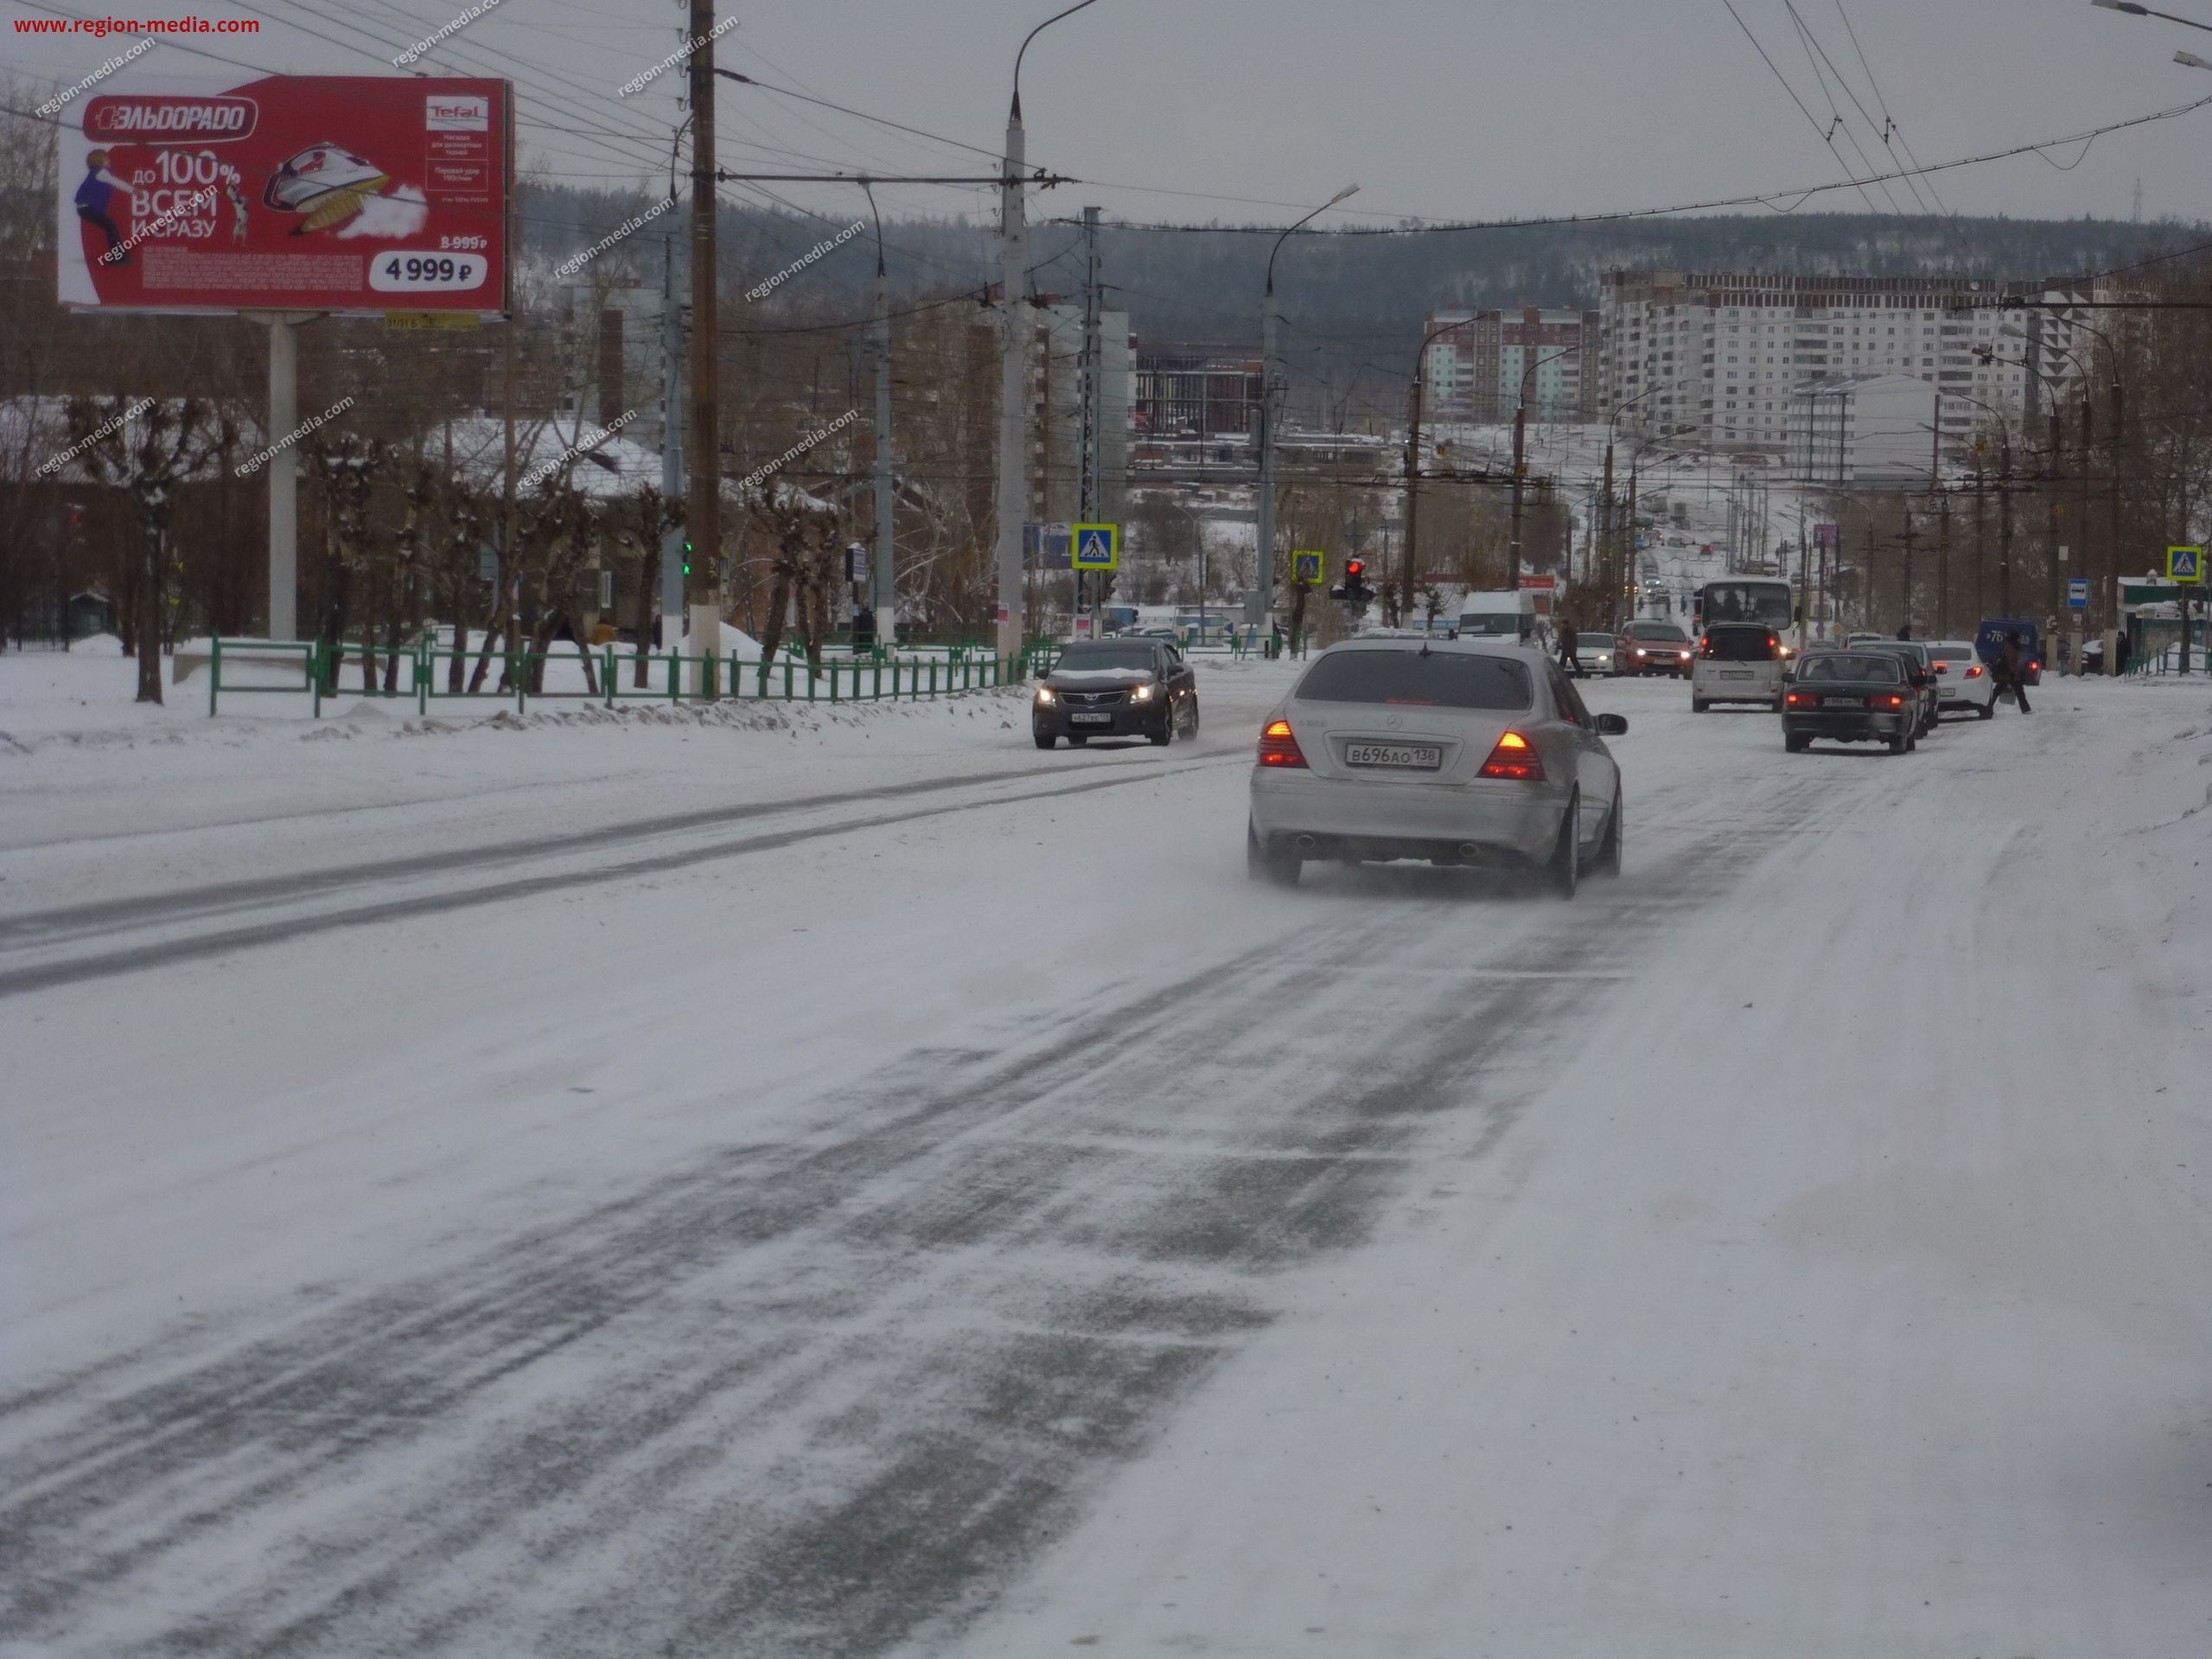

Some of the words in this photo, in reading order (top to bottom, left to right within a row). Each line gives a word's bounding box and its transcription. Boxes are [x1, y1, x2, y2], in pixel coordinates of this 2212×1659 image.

[431, 105, 479, 118] Tefal
[156, 150, 241, 185] 100%
[132, 189, 216, 216] ВСЕМ
[152, 220, 216, 238] СРАЗУ
[1352, 747, 1411, 764] В696АО
[1413, 749, 1436, 761] 138
